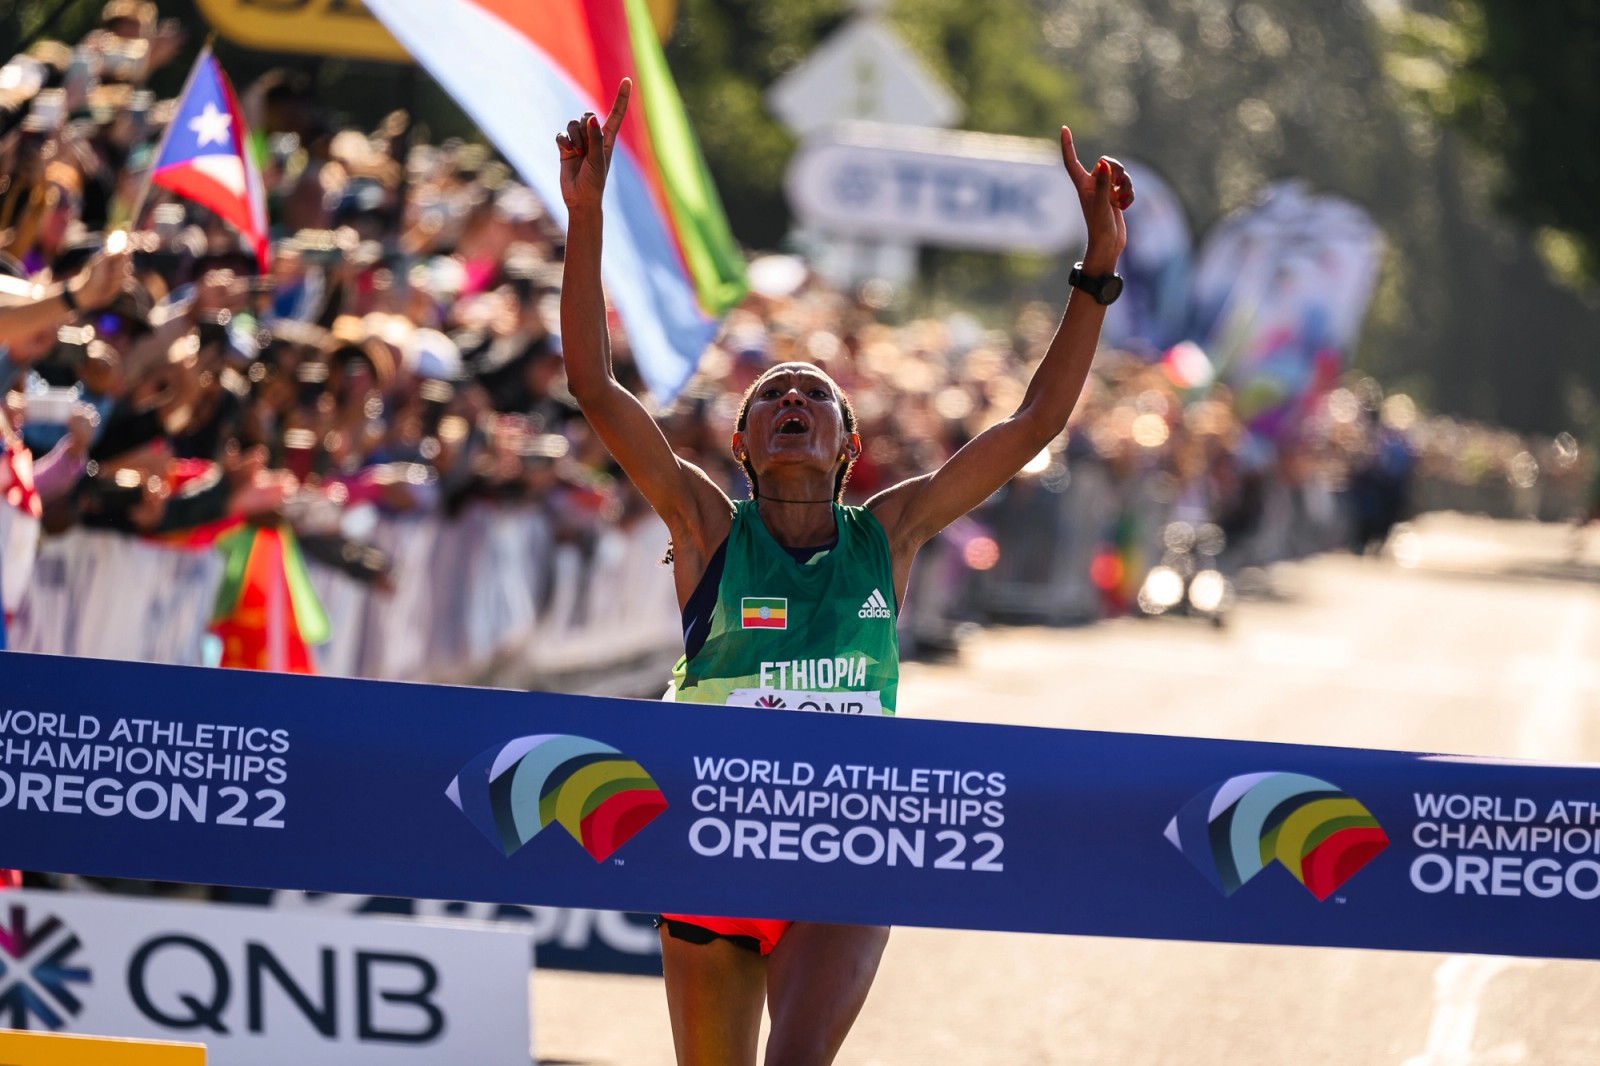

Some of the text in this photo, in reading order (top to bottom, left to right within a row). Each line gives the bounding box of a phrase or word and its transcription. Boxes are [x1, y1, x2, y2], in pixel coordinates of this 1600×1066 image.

[858, 606, 891, 619] adidas
[760, 657, 867, 690] ETHIOPIA
[108, 718, 290, 753] ATHLETICS
[0, 738, 288, 784] HAMPIONSHIPS
[693, 756, 1007, 797] WORLD ATHLETICS
[691, 784, 1005, 828] CHAMPIONSHIPS
[1413, 792, 1537, 823] WORLD
[1412, 821, 1600, 855] CHAMPIO
[127, 930, 448, 1045] QNB
